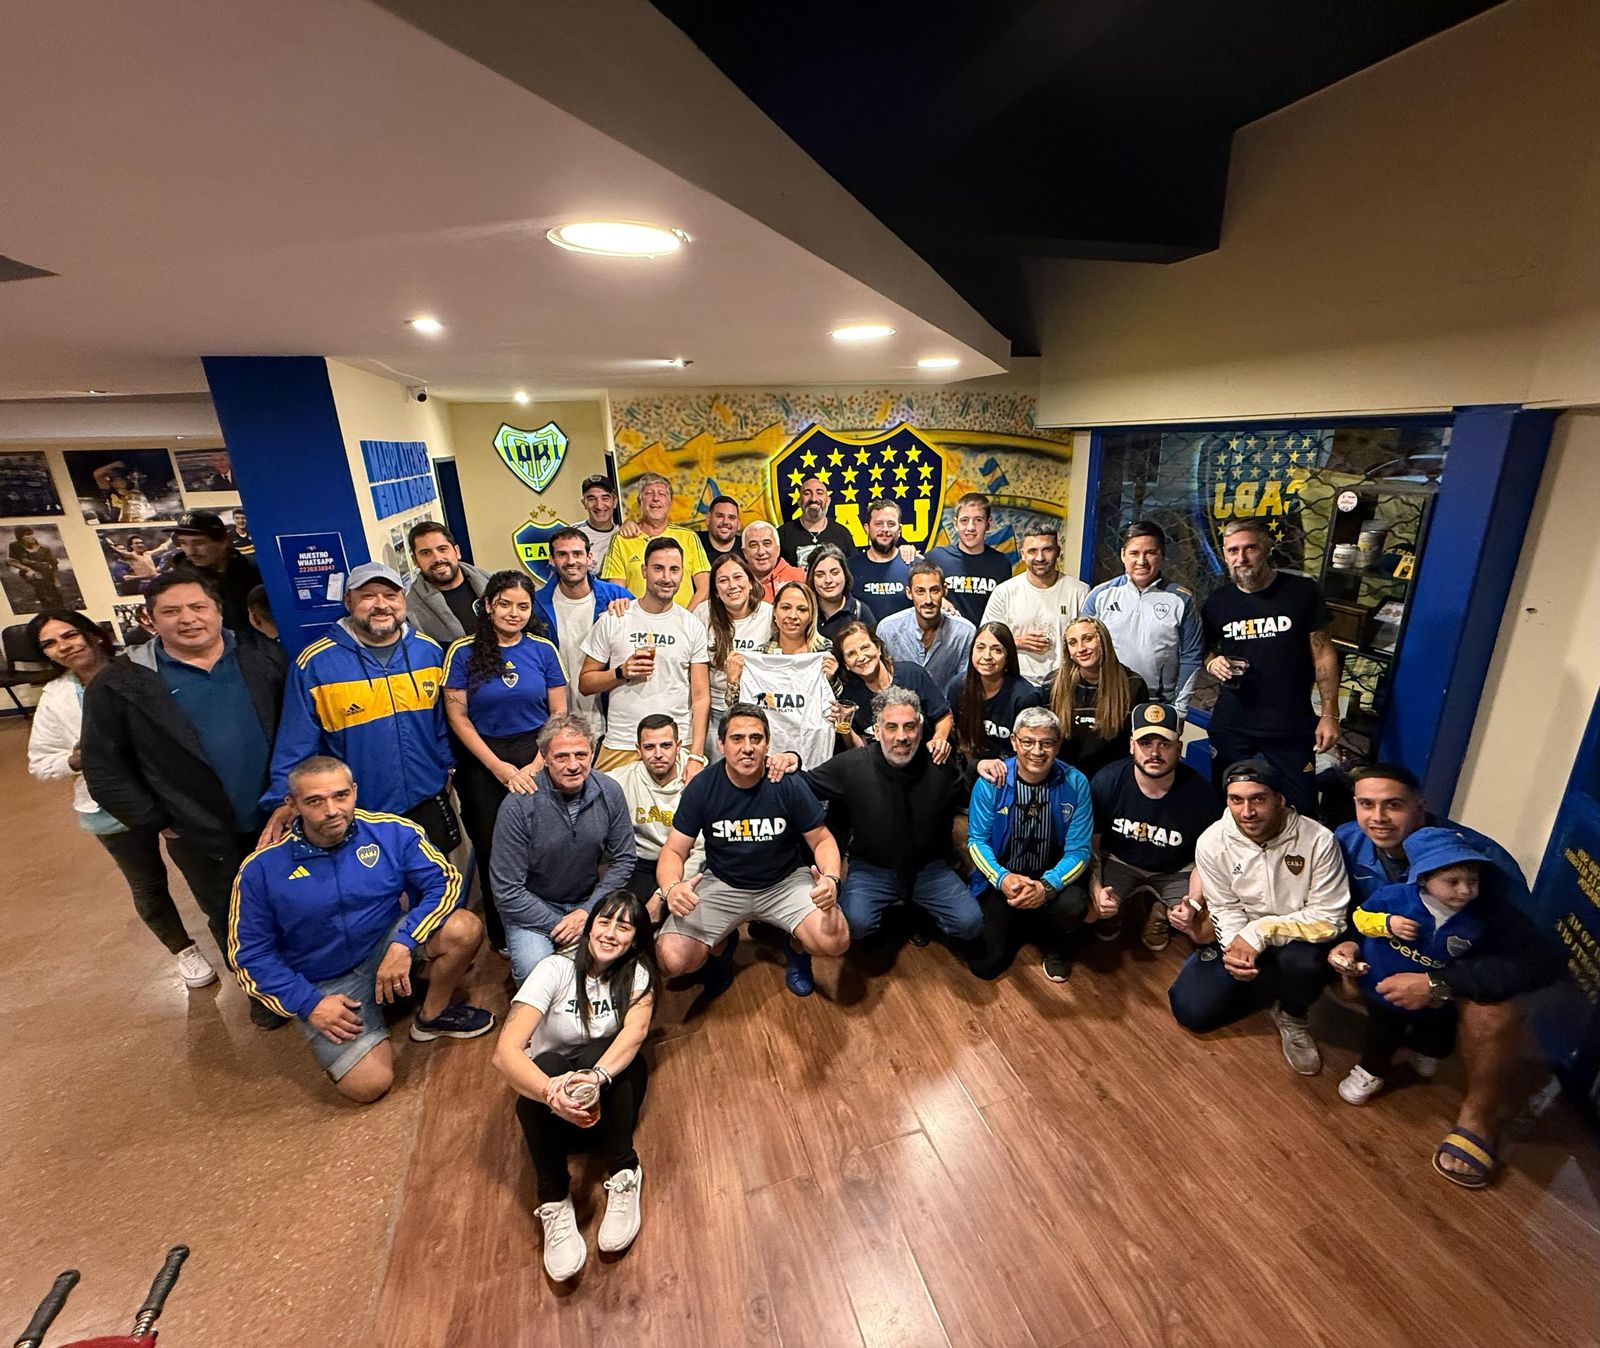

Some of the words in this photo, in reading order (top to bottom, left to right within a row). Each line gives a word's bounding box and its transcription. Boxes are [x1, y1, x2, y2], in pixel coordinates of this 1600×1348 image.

[299, 551, 329, 559] NUESTRO
[297, 558, 334, 567] WHATSAPP
[1259, 631, 1276, 639] PLATA
[735, 639, 754, 649] TAD
